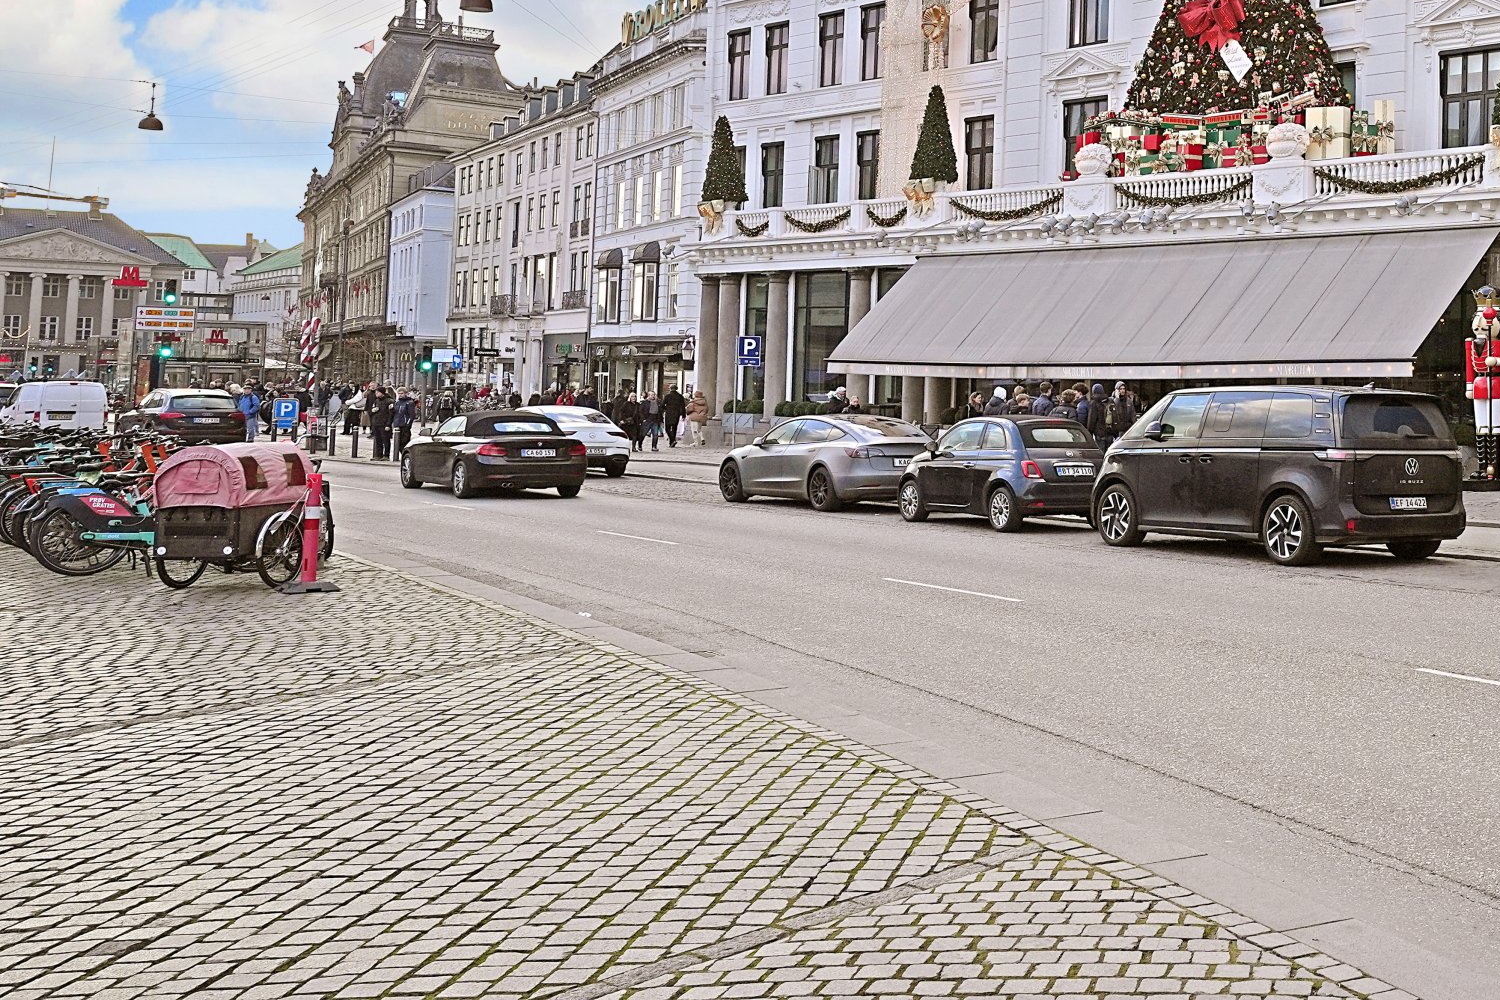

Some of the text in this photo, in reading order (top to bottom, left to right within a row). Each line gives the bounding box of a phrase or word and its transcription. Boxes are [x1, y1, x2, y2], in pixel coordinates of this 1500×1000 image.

[744, 338, 757, 355] P
[1276, 365, 1317, 376] MARCHAL
[280, 402, 293, 417] P
[1405, 499, 1413, 507] 14
[1414, 499, 1426, 507] 422
